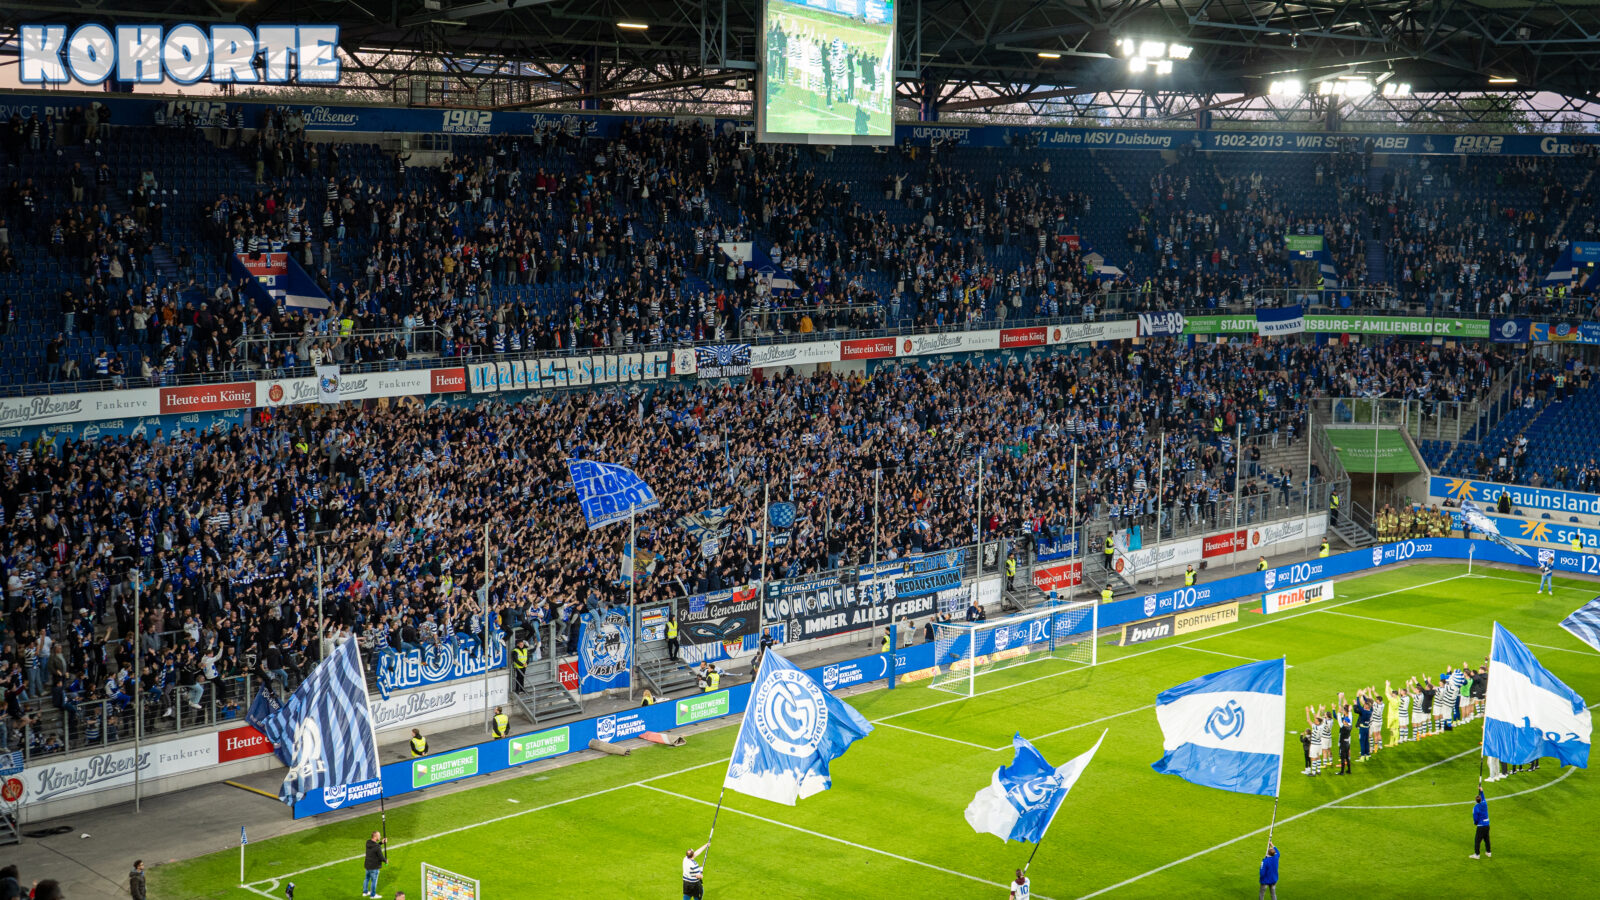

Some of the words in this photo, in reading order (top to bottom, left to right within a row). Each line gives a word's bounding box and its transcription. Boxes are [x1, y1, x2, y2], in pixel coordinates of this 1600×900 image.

[443, 111, 493, 127] 1902
[1051, 132, 1082, 144] Jahre
[1084, 132, 1115, 145] MSV
[1116, 133, 1172, 148] Duisburg
[1214, 135, 1284, 148] 1902-2013
[1296, 136, 1322, 148] WIR
[1454, 136, 1504, 149] 1902
[1002, 334, 1019, 343] Heute
[1020, 332, 1028, 341] ein
[1029, 330, 1046, 342] König
[752, 349, 768, 363] önig
[767, 346, 796, 361] Pilsener
[844, 345, 864, 355] Heute
[865, 345, 875, 353] ein
[876, 342, 894, 354] König
[378, 379, 421, 389] Fankurve
[436, 375, 464, 386] Heute
[167, 394, 200, 406] Heute
[204, 392, 218, 403] ein
[220, 389, 251, 404] König
[0, 403, 31, 421] önig
[30, 397, 82, 417] Pilsener
[96, 400, 148, 411] Fankurve
[1396, 541, 1415, 560] 120
[1416, 544, 1432, 552] 2022
[1560, 557, 1579, 567] 1902
[1582, 555, 1600, 574] 12
[1278, 572, 1289, 582] 1902
[1290, 563, 1311, 584] 120
[1311, 565, 1323, 575] 2022
[764, 586, 855, 619] KOHORTE
[1159, 598, 1172, 608] 1902
[1173, 588, 1196, 610] 120
[1197, 590, 1211, 600] 2022
[1278, 585, 1323, 606] trinkgut
[711, 600, 758, 619] Generation
[805, 612, 849, 635] IMMER
[851, 603, 889, 625] ALLES
[892, 595, 933, 617] GEBEN!
[1131, 622, 1170, 642] bwin
[1177, 608, 1237, 629] SPORTWETTEN
[788, 671, 805, 681] SV
[805, 681, 819, 696] 02
[839, 673, 863, 685] PARTNER
[407, 690, 457, 714] Pilsener
[690, 696, 727, 712] STADTWERKE
[690, 707, 720, 721] DUISBURG
[616, 724, 646, 738] PARTNER
[226, 736, 264, 752] Heute
[525, 733, 566, 752] STADTWERKE
[525, 744, 557, 759] DUISBURG
[35, 767, 88, 796] König
[87, 752, 150, 781] Pilsener
[160, 747, 211, 764] Fankurve
[430, 755, 474, 774] STADTWERKE
[430, 767, 465, 783] DUISBURG
[1020, 884, 1029, 895] 10
